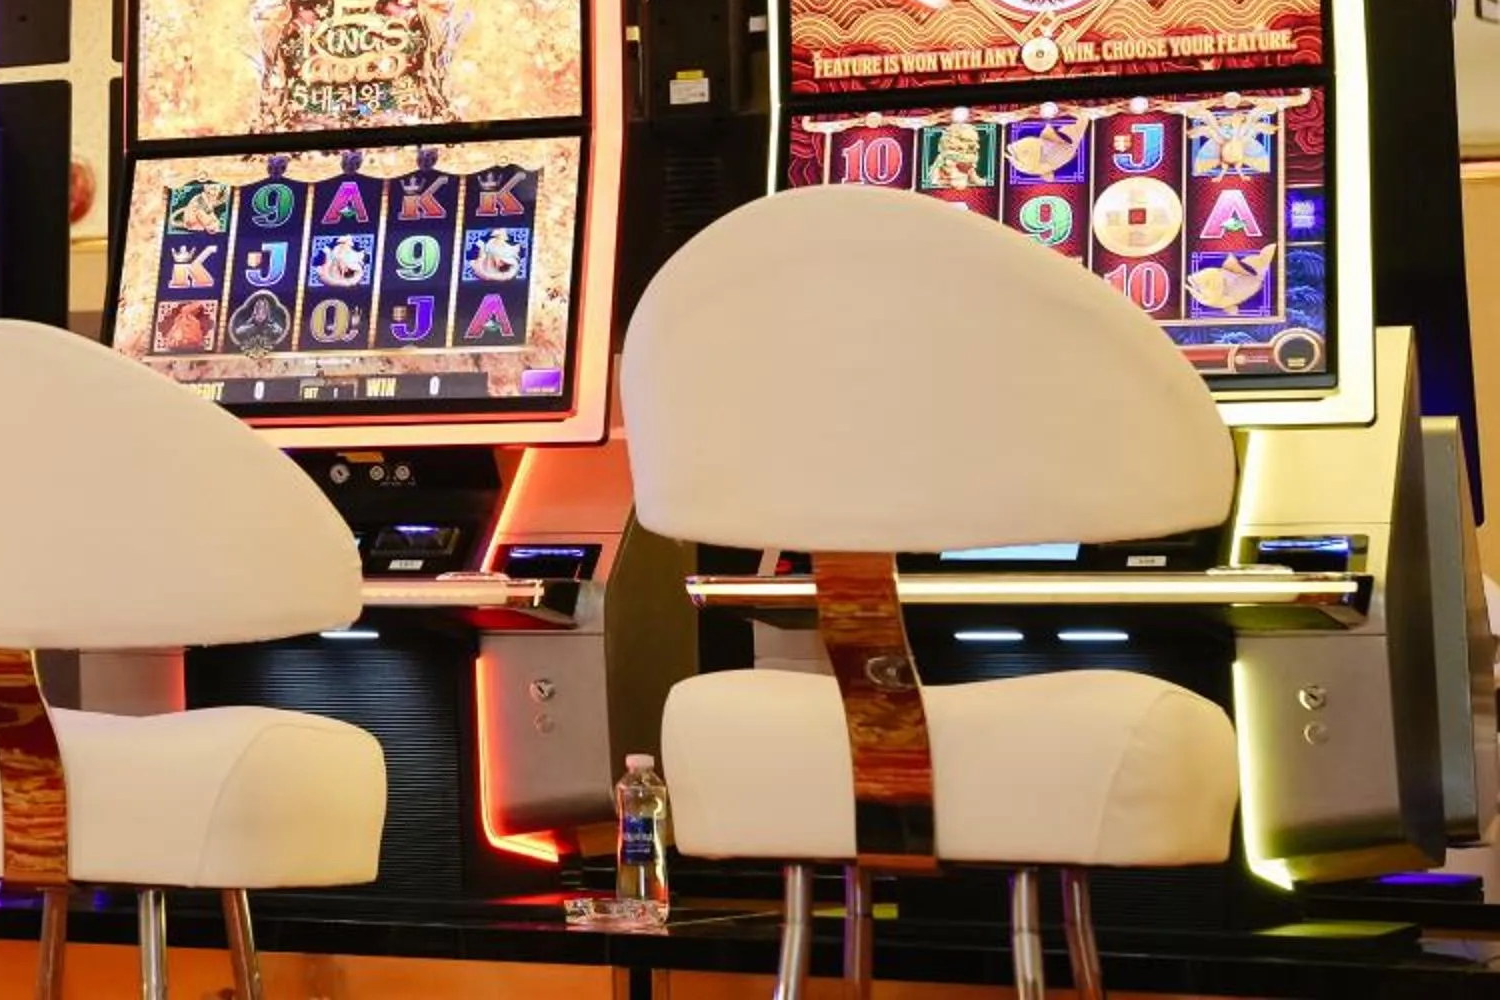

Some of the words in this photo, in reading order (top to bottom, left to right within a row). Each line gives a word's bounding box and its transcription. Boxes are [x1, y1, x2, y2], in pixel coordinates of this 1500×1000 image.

[302, 19, 410, 59] KINGS
[814, 52, 882, 79] FEATURE
[884, 55, 900, 74] IS
[901, 52, 939, 73] WON
[940, 49, 984, 71] WITH
[984, 46, 1020, 68] ANY
[1061, 40, 1100, 63] WIN.
[1103, 37, 1167, 60] CHOOSE
[1167, 34, 1216, 57] YOUR
[1217, 30, 1297, 55] FEATURE.
[842, 137, 902, 184] 10
[251, 183, 295, 228] 9
[322, 181, 370, 225] A
[399, 175, 449, 221] K
[475, 171, 527, 217] K
[1019, 195, 1073, 246] 9
[1200, 189, 1263, 239] A
[168, 244, 218, 289] K
[245, 242, 289, 287] J
[396, 235, 441, 281] 9
[310, 298, 358, 344] Q
[390, 296, 436, 342] J
[464, 294, 515, 339] A
[366, 377, 398, 397] WIN
